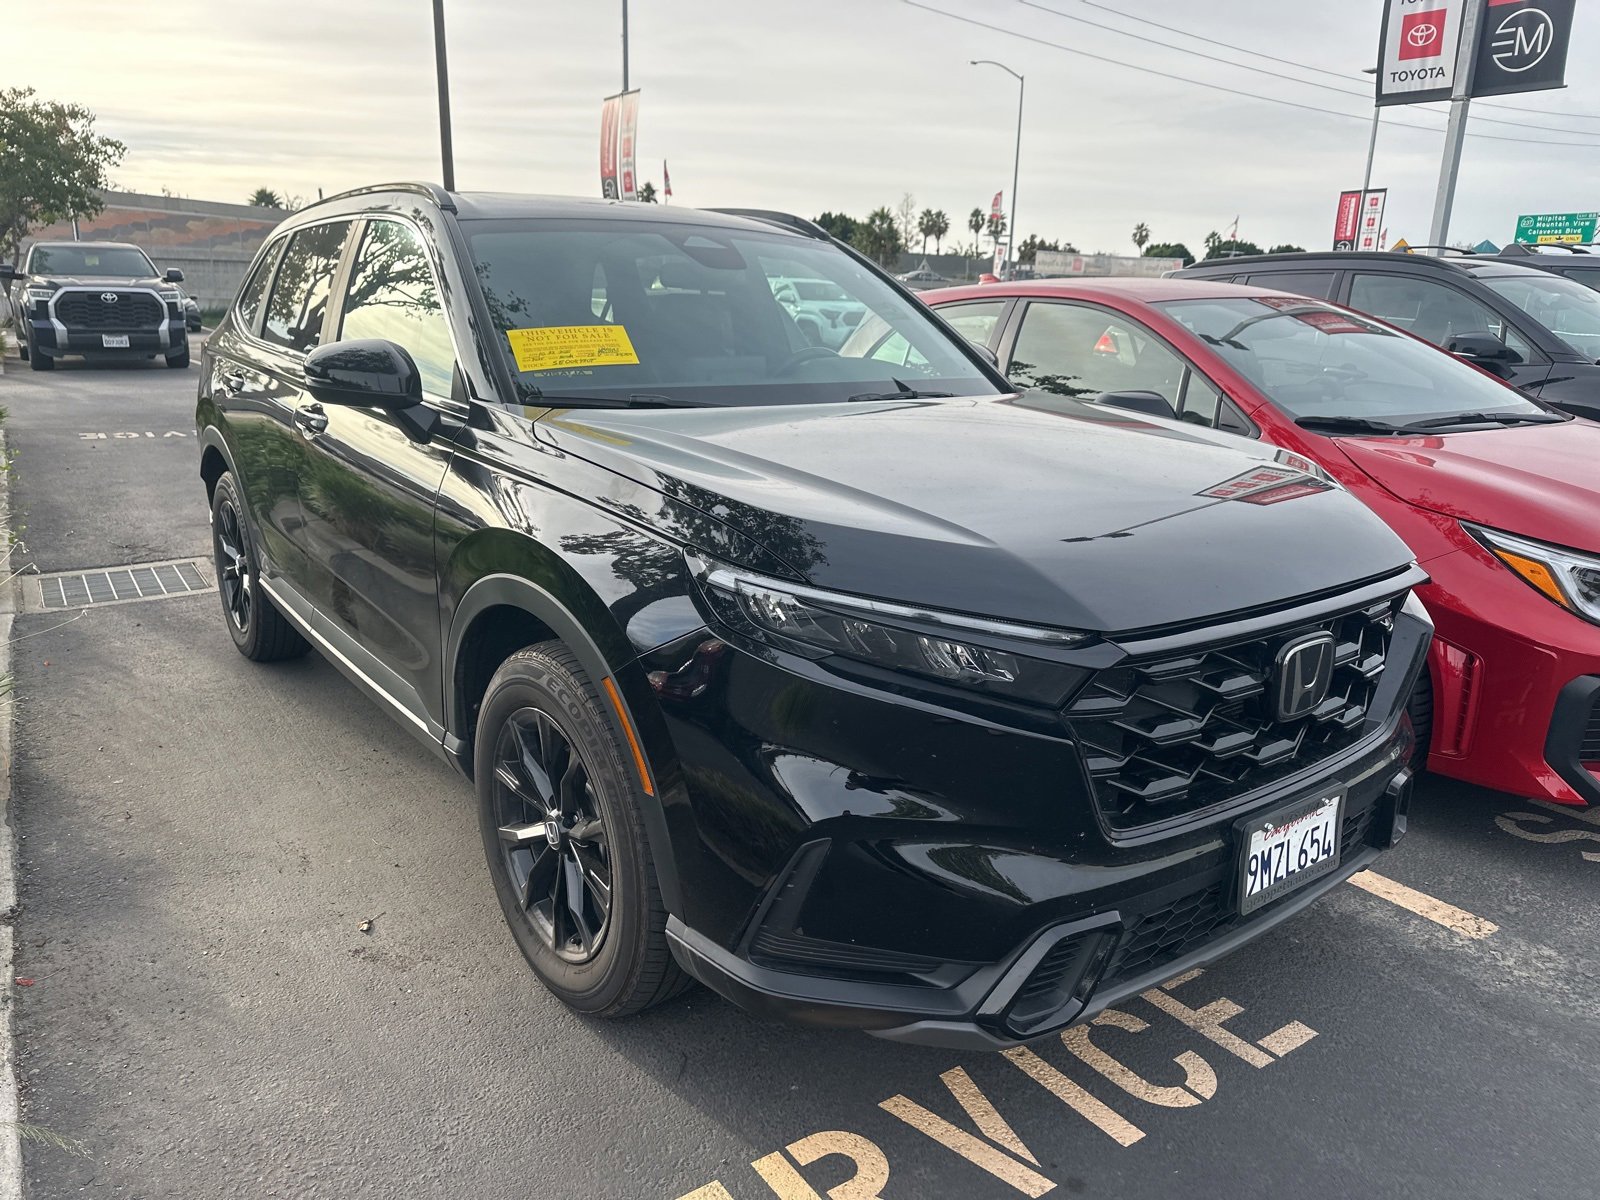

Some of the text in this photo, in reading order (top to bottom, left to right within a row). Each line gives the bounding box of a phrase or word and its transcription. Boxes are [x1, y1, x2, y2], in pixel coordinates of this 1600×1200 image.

[1390, 66, 1445, 83] TOYOTA
[549, 327, 600, 335] VEHICLE
[1247, 820, 1332, 898] 9MZL654
